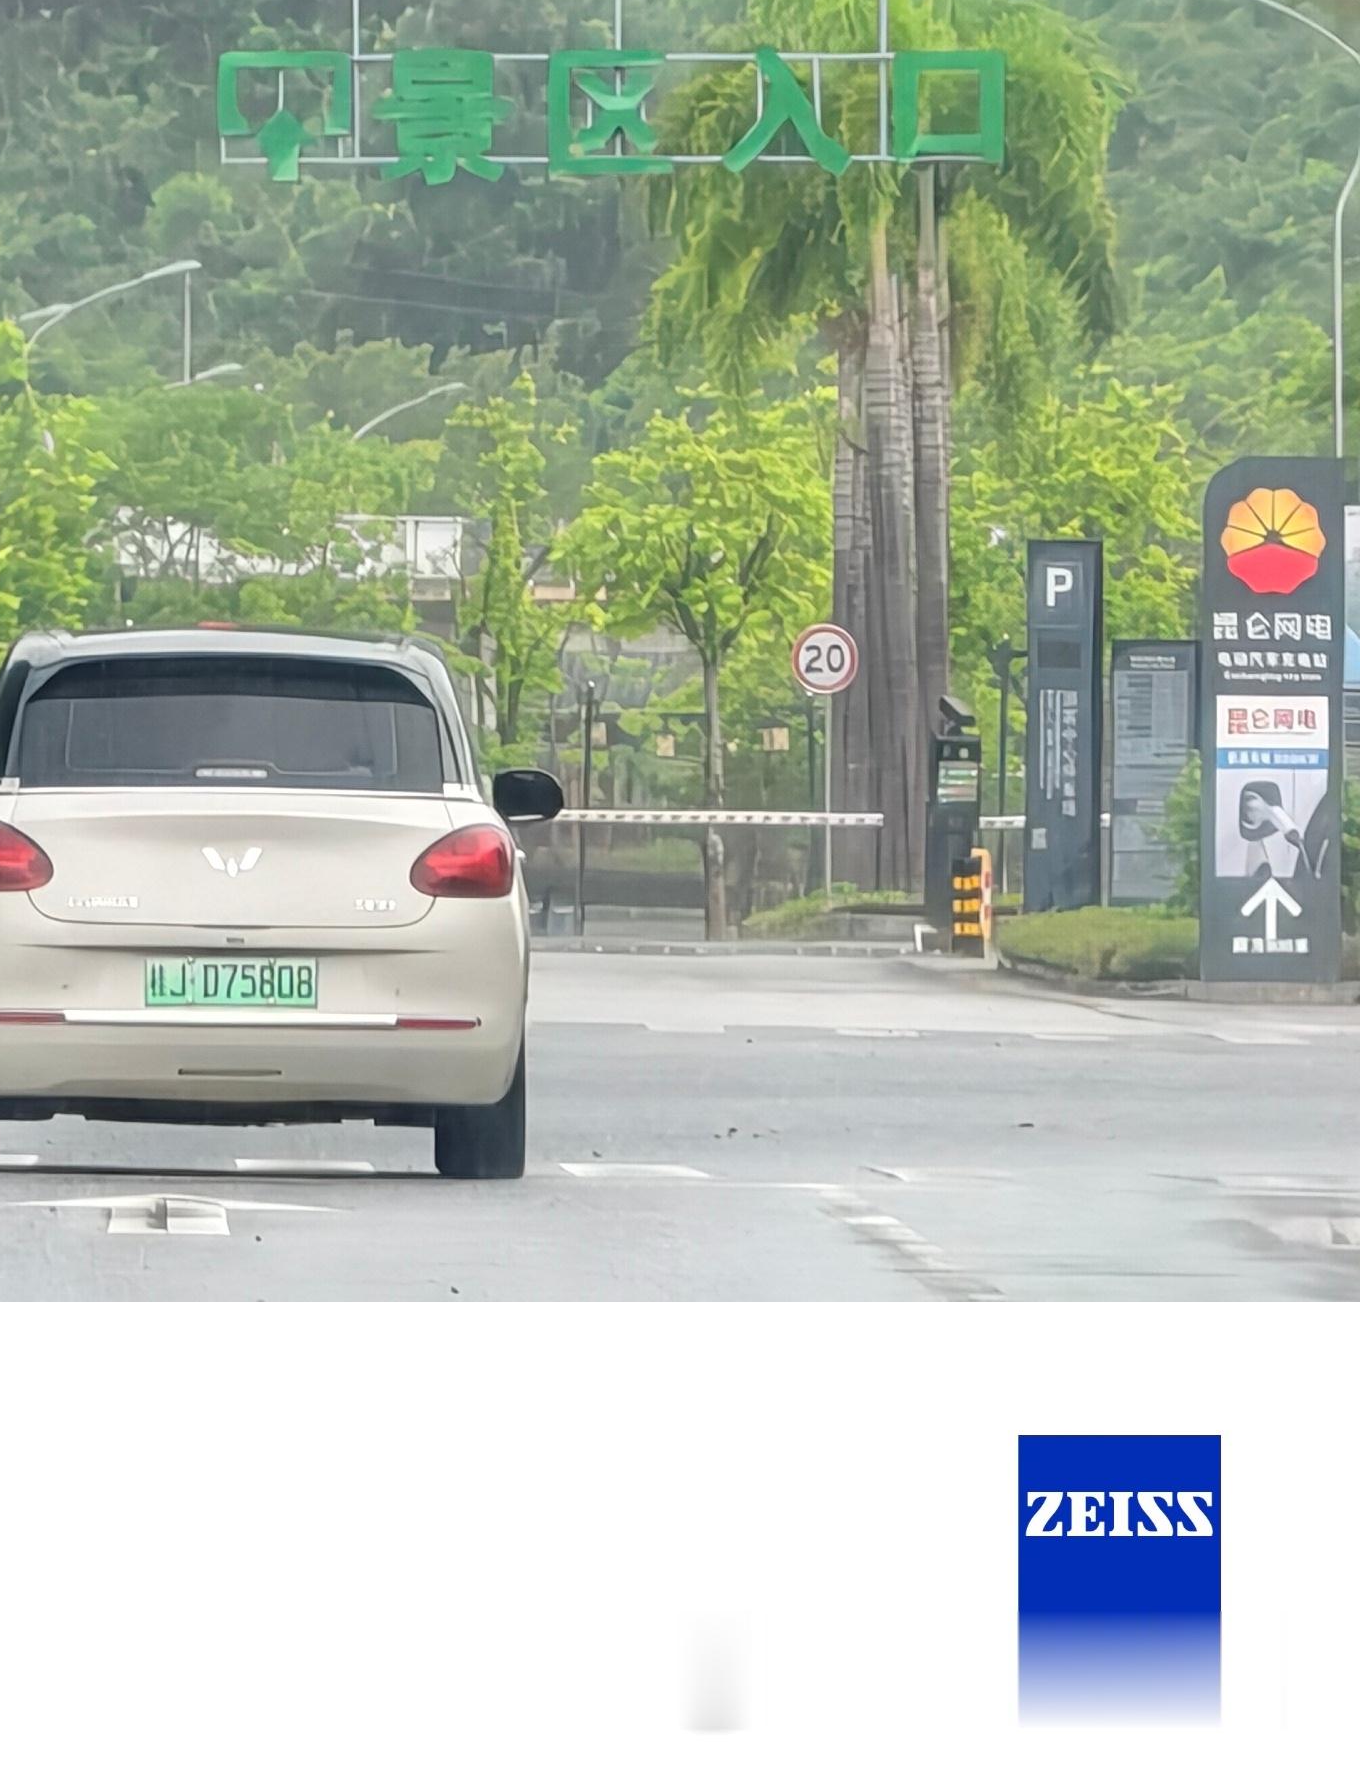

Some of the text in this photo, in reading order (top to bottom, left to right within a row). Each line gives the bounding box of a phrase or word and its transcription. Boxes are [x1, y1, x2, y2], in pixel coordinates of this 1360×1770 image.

[373, 47, 1007, 186] 景区入口
[1046, 566, 1073, 607] P
[805, 644, 845, 673] 20
